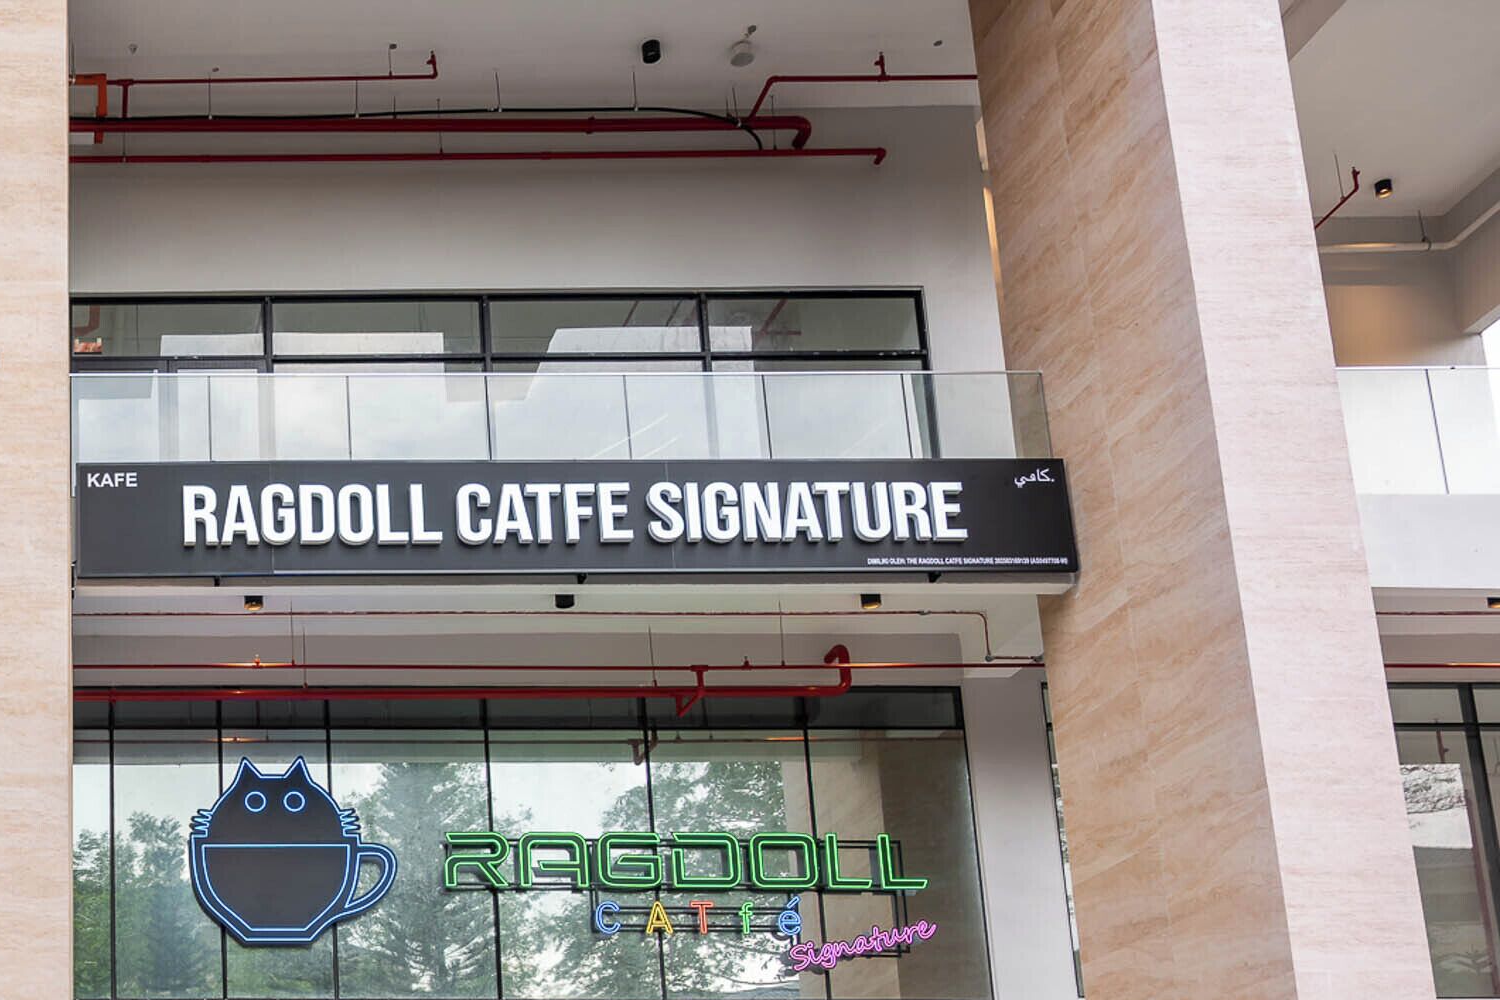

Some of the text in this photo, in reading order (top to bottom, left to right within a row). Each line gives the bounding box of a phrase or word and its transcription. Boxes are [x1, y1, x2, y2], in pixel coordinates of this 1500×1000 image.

[86, 472, 138, 488] KAFE
[182, 481, 969, 547] RAGDOLL CATFE SIGNATURE
[444, 831, 928, 890] RAGDOLL
[788, 918, 937, 972] Signature
